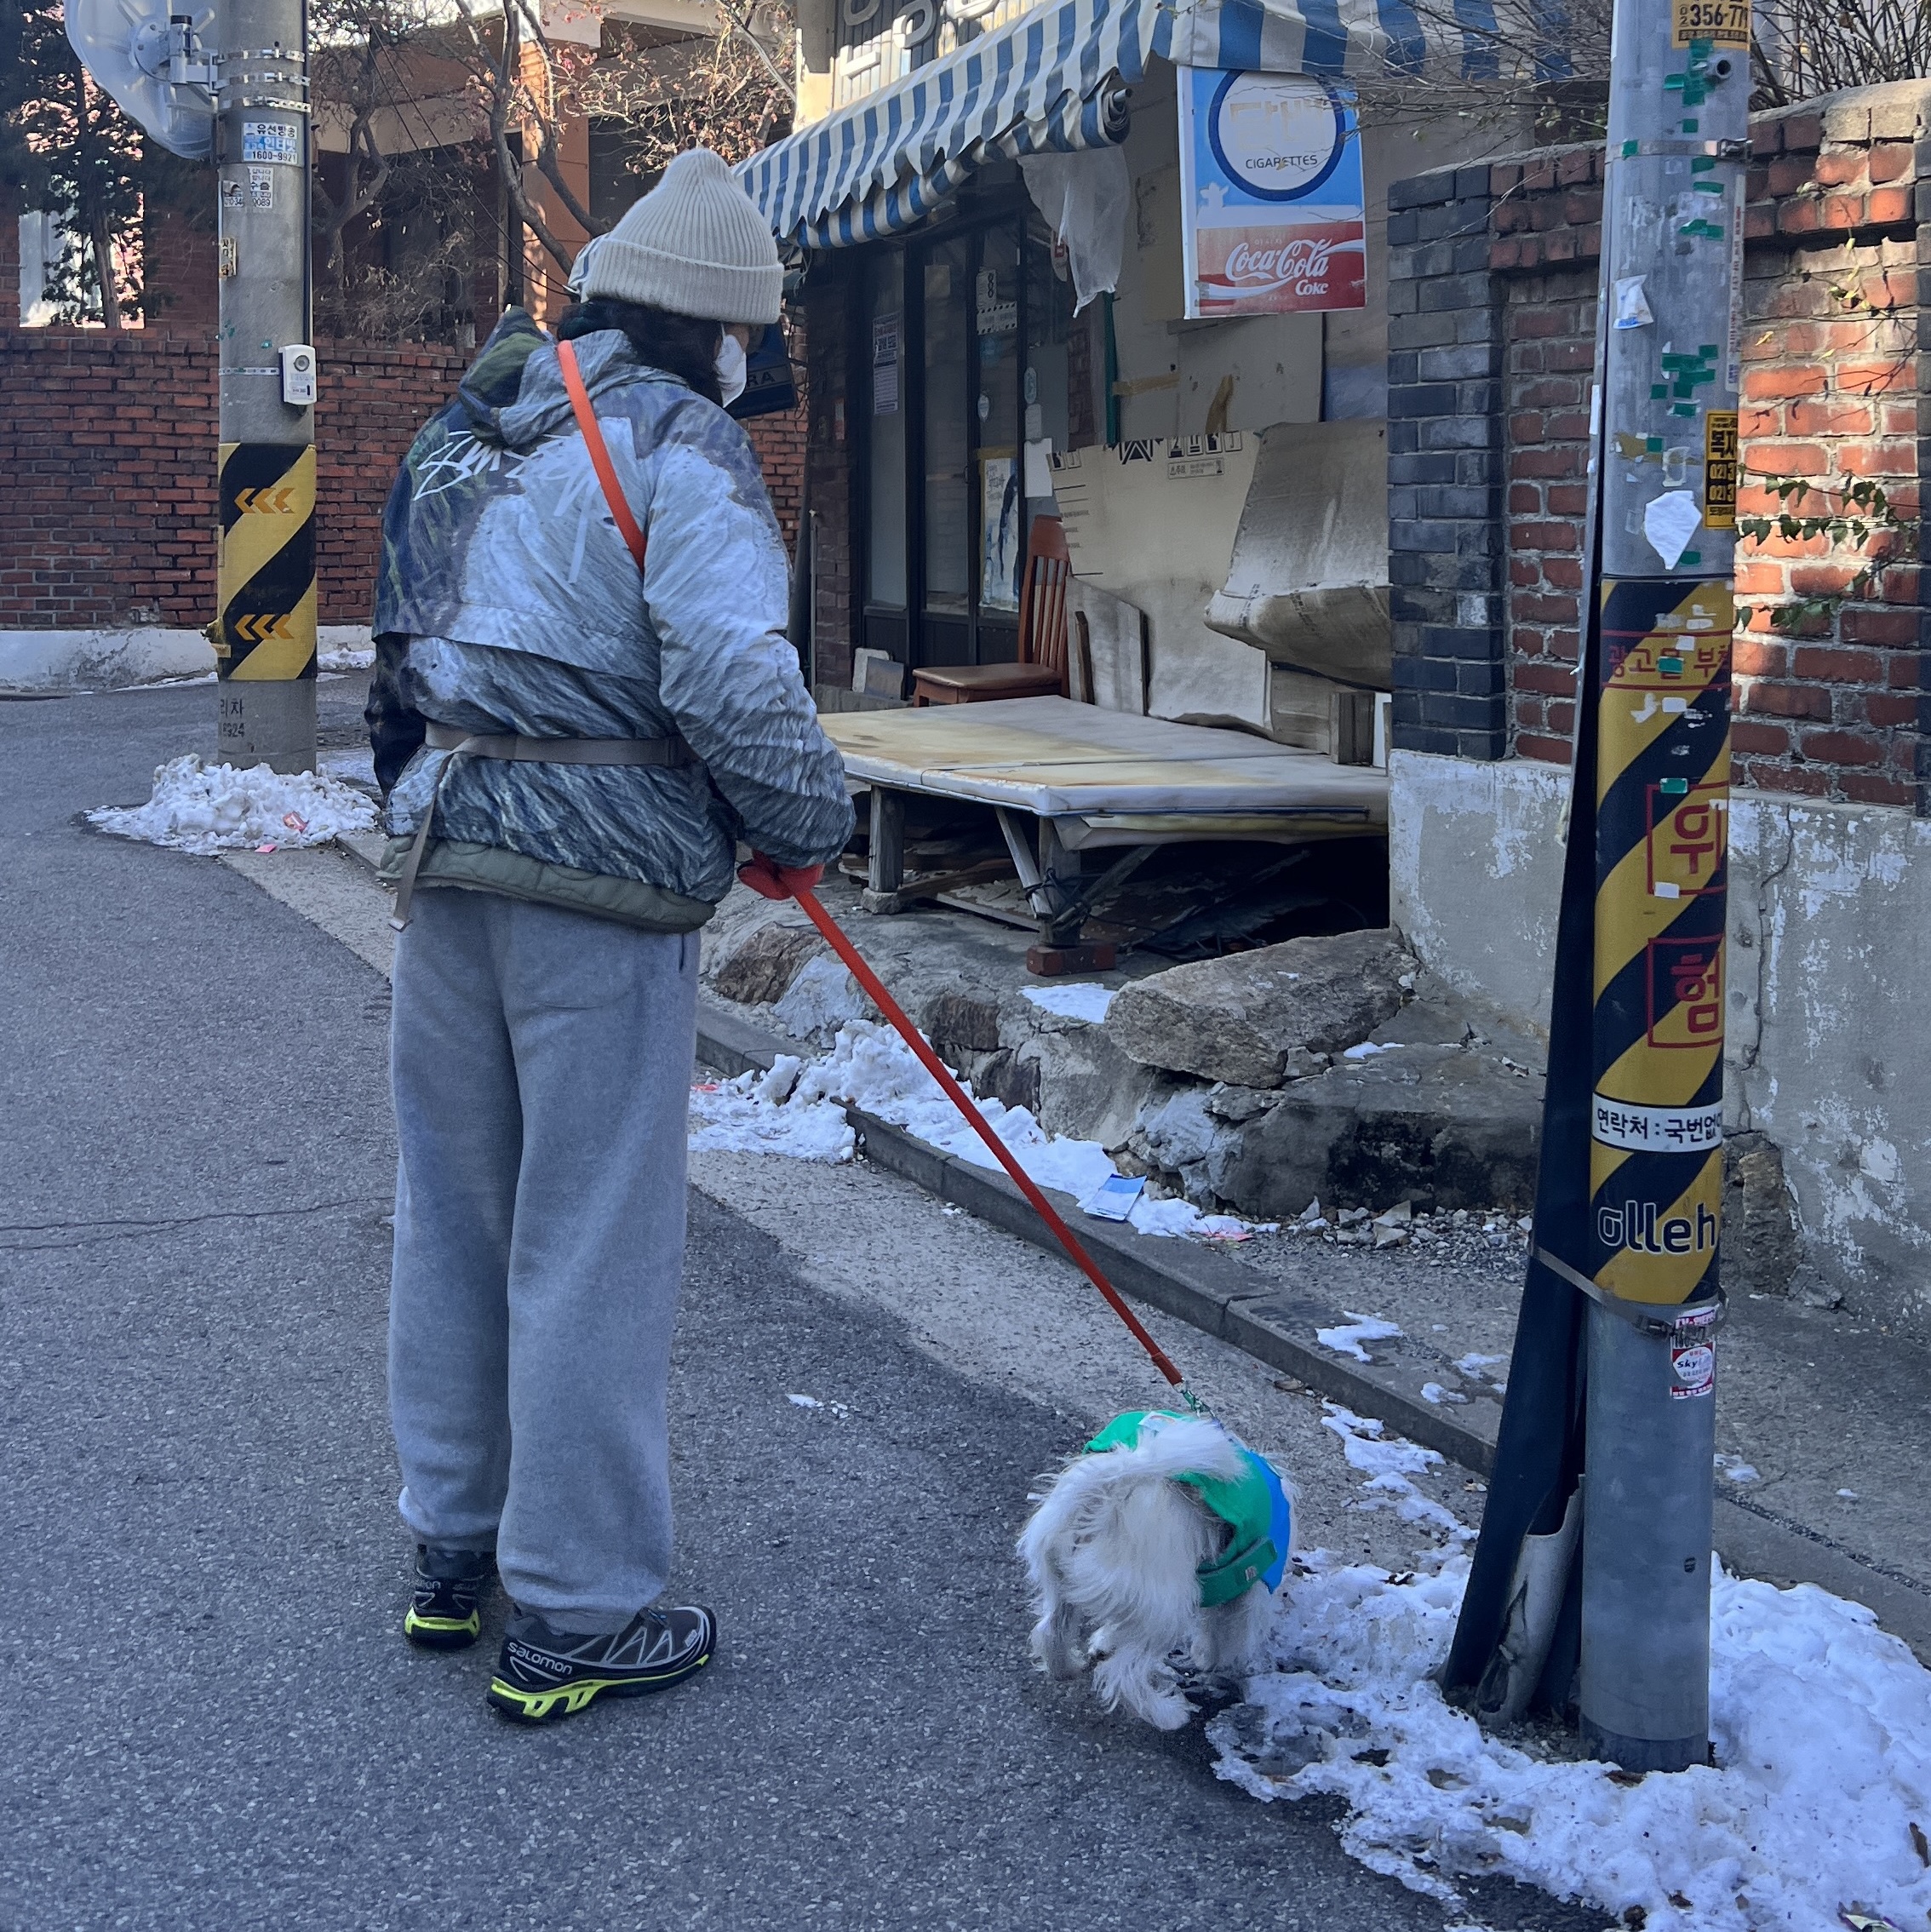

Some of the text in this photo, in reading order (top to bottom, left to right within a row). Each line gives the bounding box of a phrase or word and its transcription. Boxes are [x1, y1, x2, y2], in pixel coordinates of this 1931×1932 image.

[257, 123, 295, 138] 유선방송
[1295, 278, 1330, 295] Coke
[1597, 1108, 1647, 1139] 연락처
[1597, 1200, 1717, 1255] olleh
